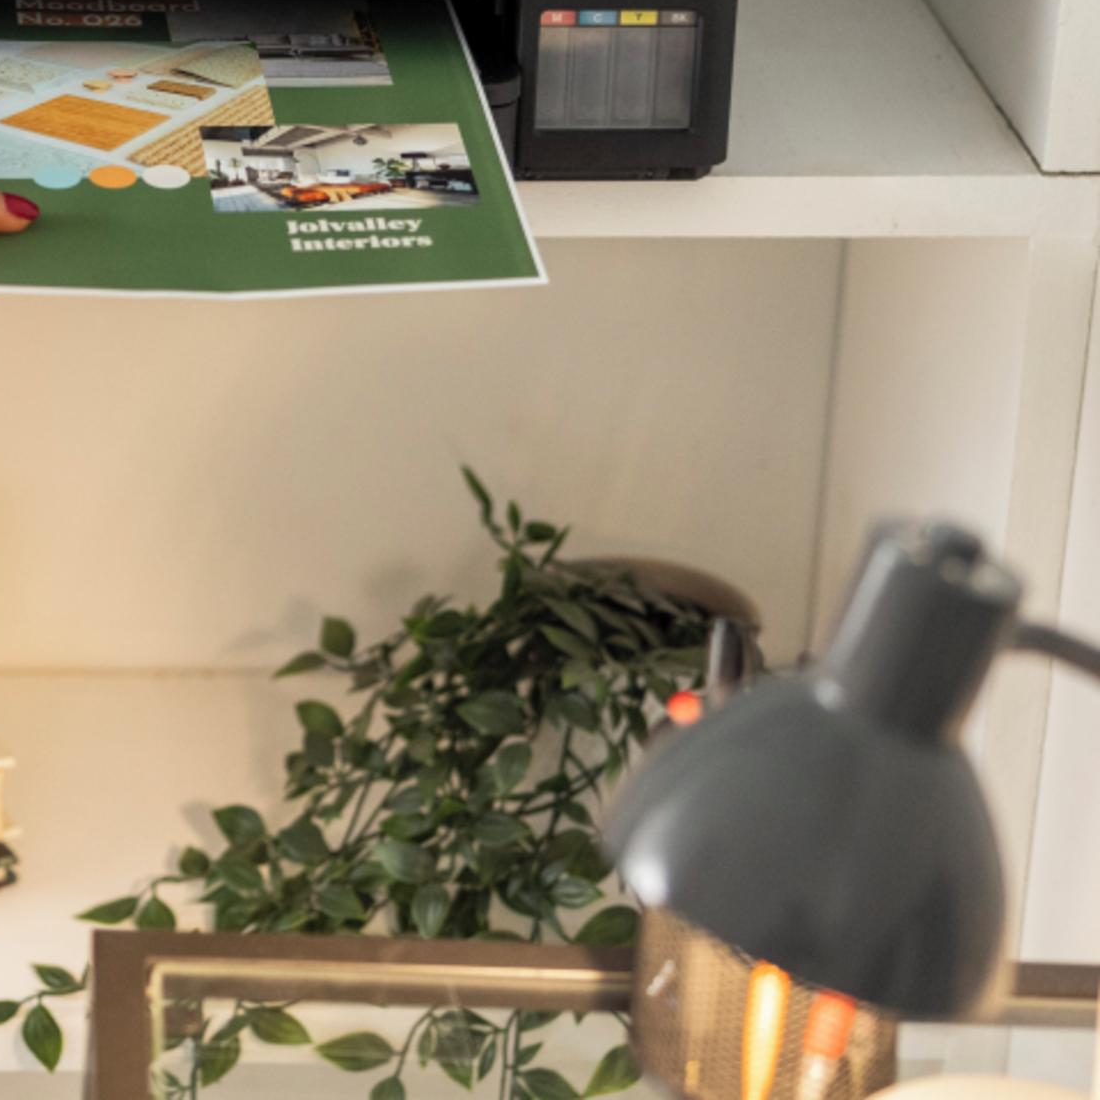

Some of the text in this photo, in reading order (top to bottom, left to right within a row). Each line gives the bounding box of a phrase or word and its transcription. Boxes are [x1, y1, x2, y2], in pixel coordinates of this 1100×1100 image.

[16, 11, 143, 26] No. 026
[289, 235, 434, 252] Interiors
